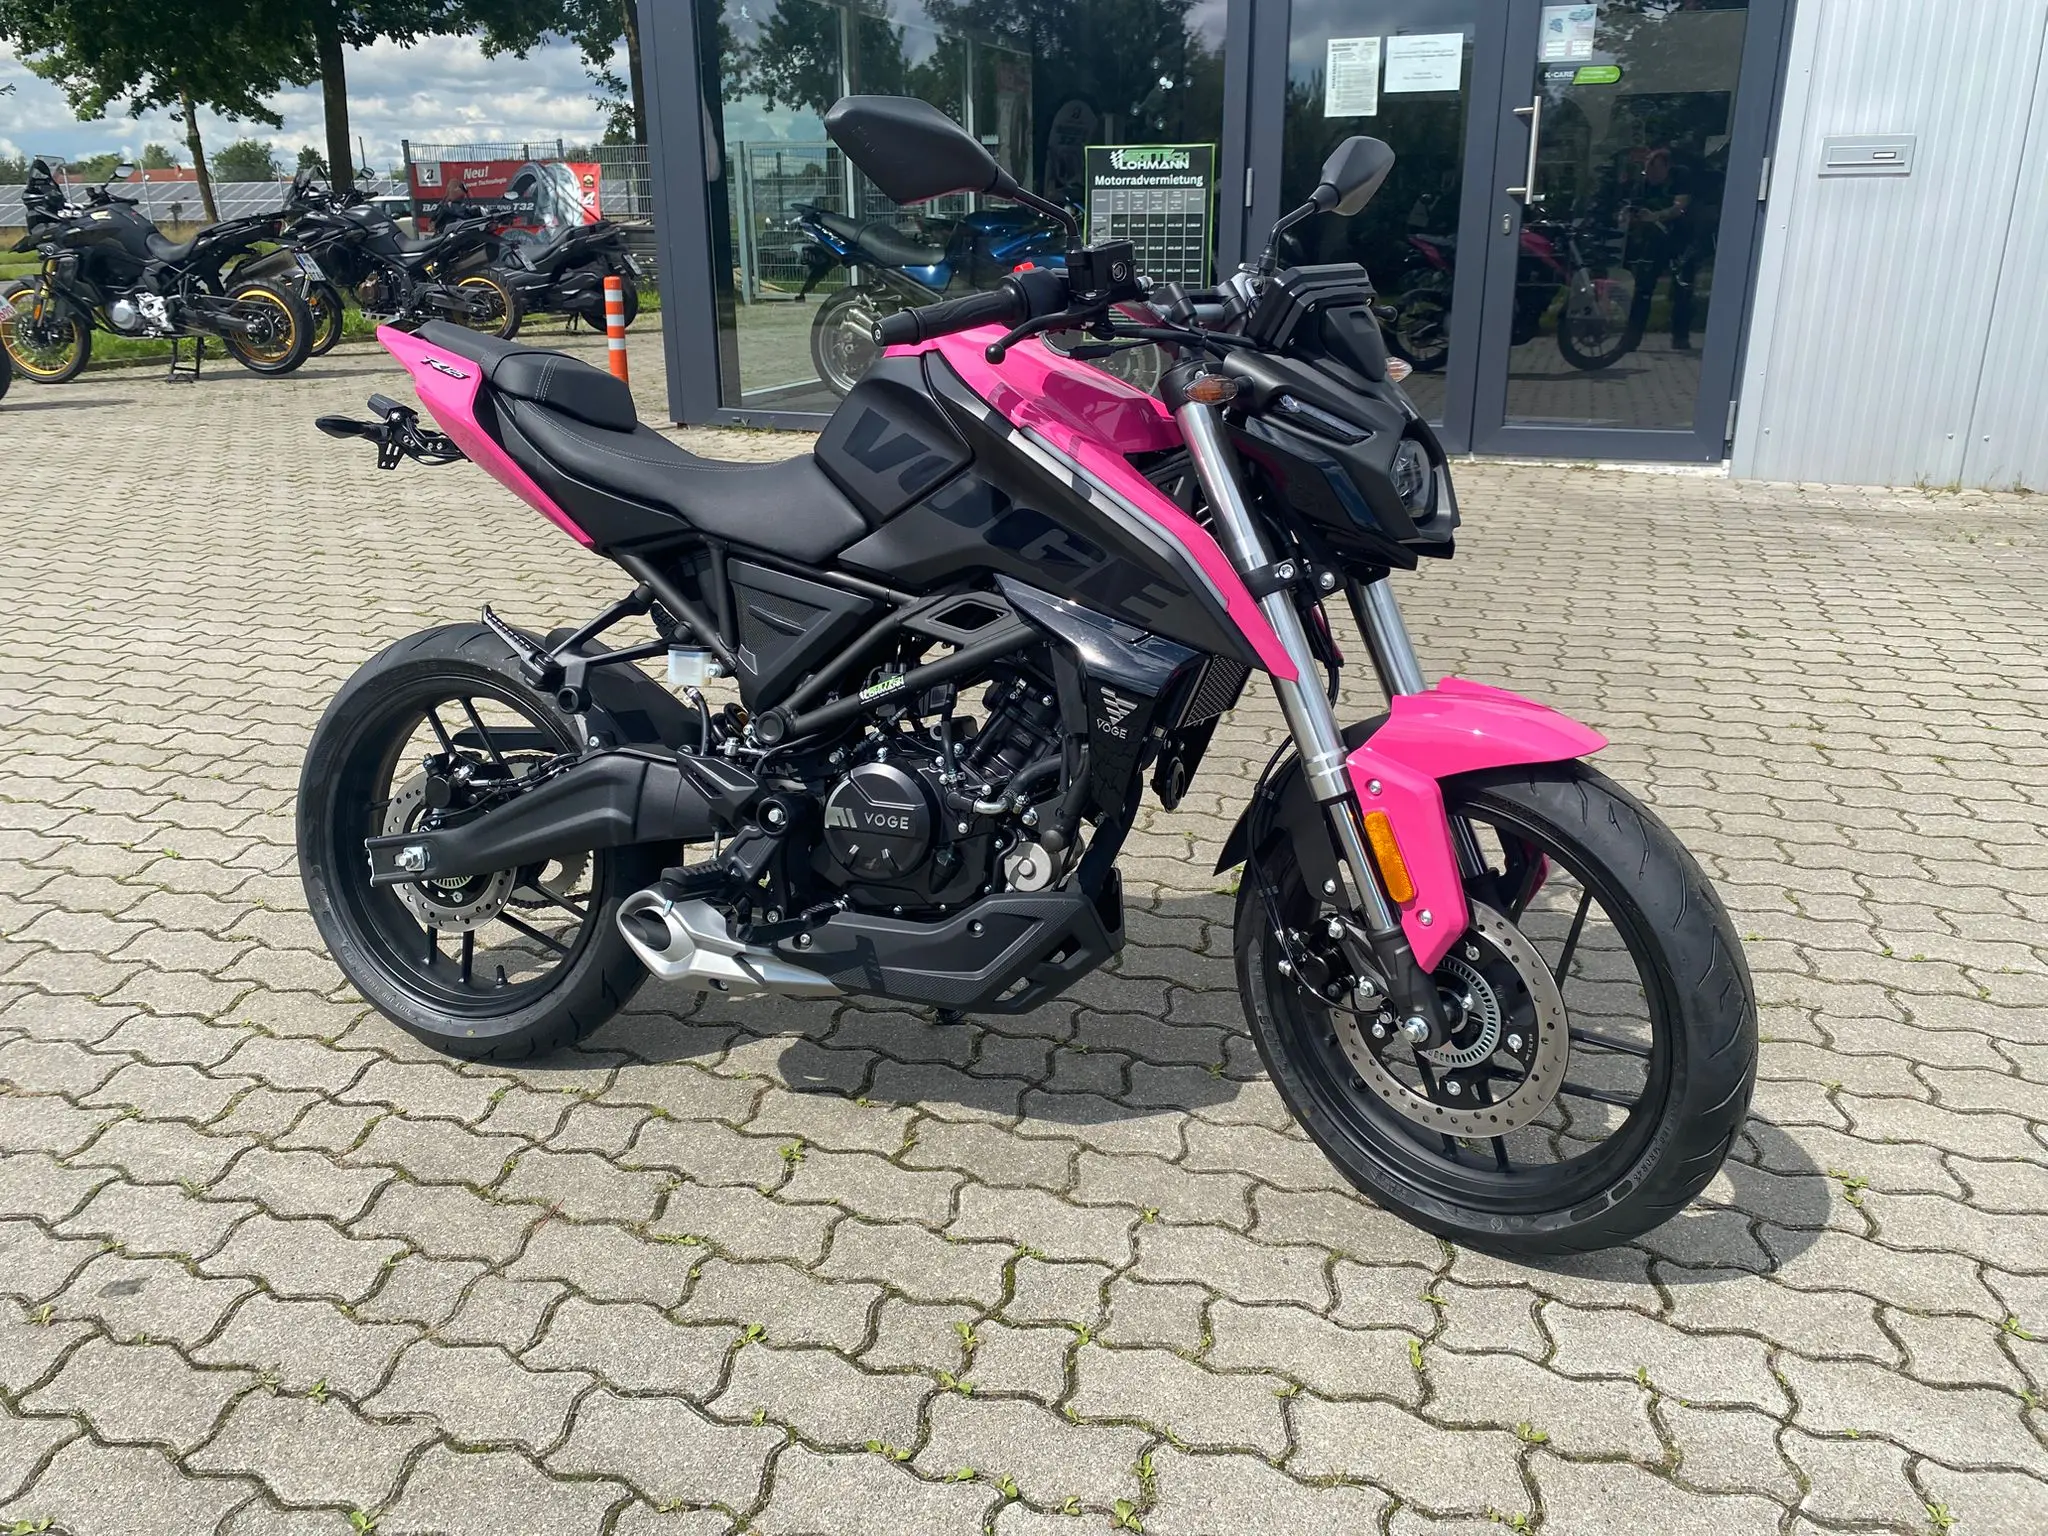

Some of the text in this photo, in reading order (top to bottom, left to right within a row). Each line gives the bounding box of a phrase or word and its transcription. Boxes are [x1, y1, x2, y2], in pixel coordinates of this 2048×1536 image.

[463, 165, 489, 180] Neu!
[1119, 160, 1190, 170] LOHMANN
[1095, 174, 1204, 188] Motorradvermietung
[512, 203, 535, 211] T32
[842, 406, 1190, 623] VOGE
[1096, 717, 1129, 740] VOGE
[864, 812, 910, 830] VOGE
